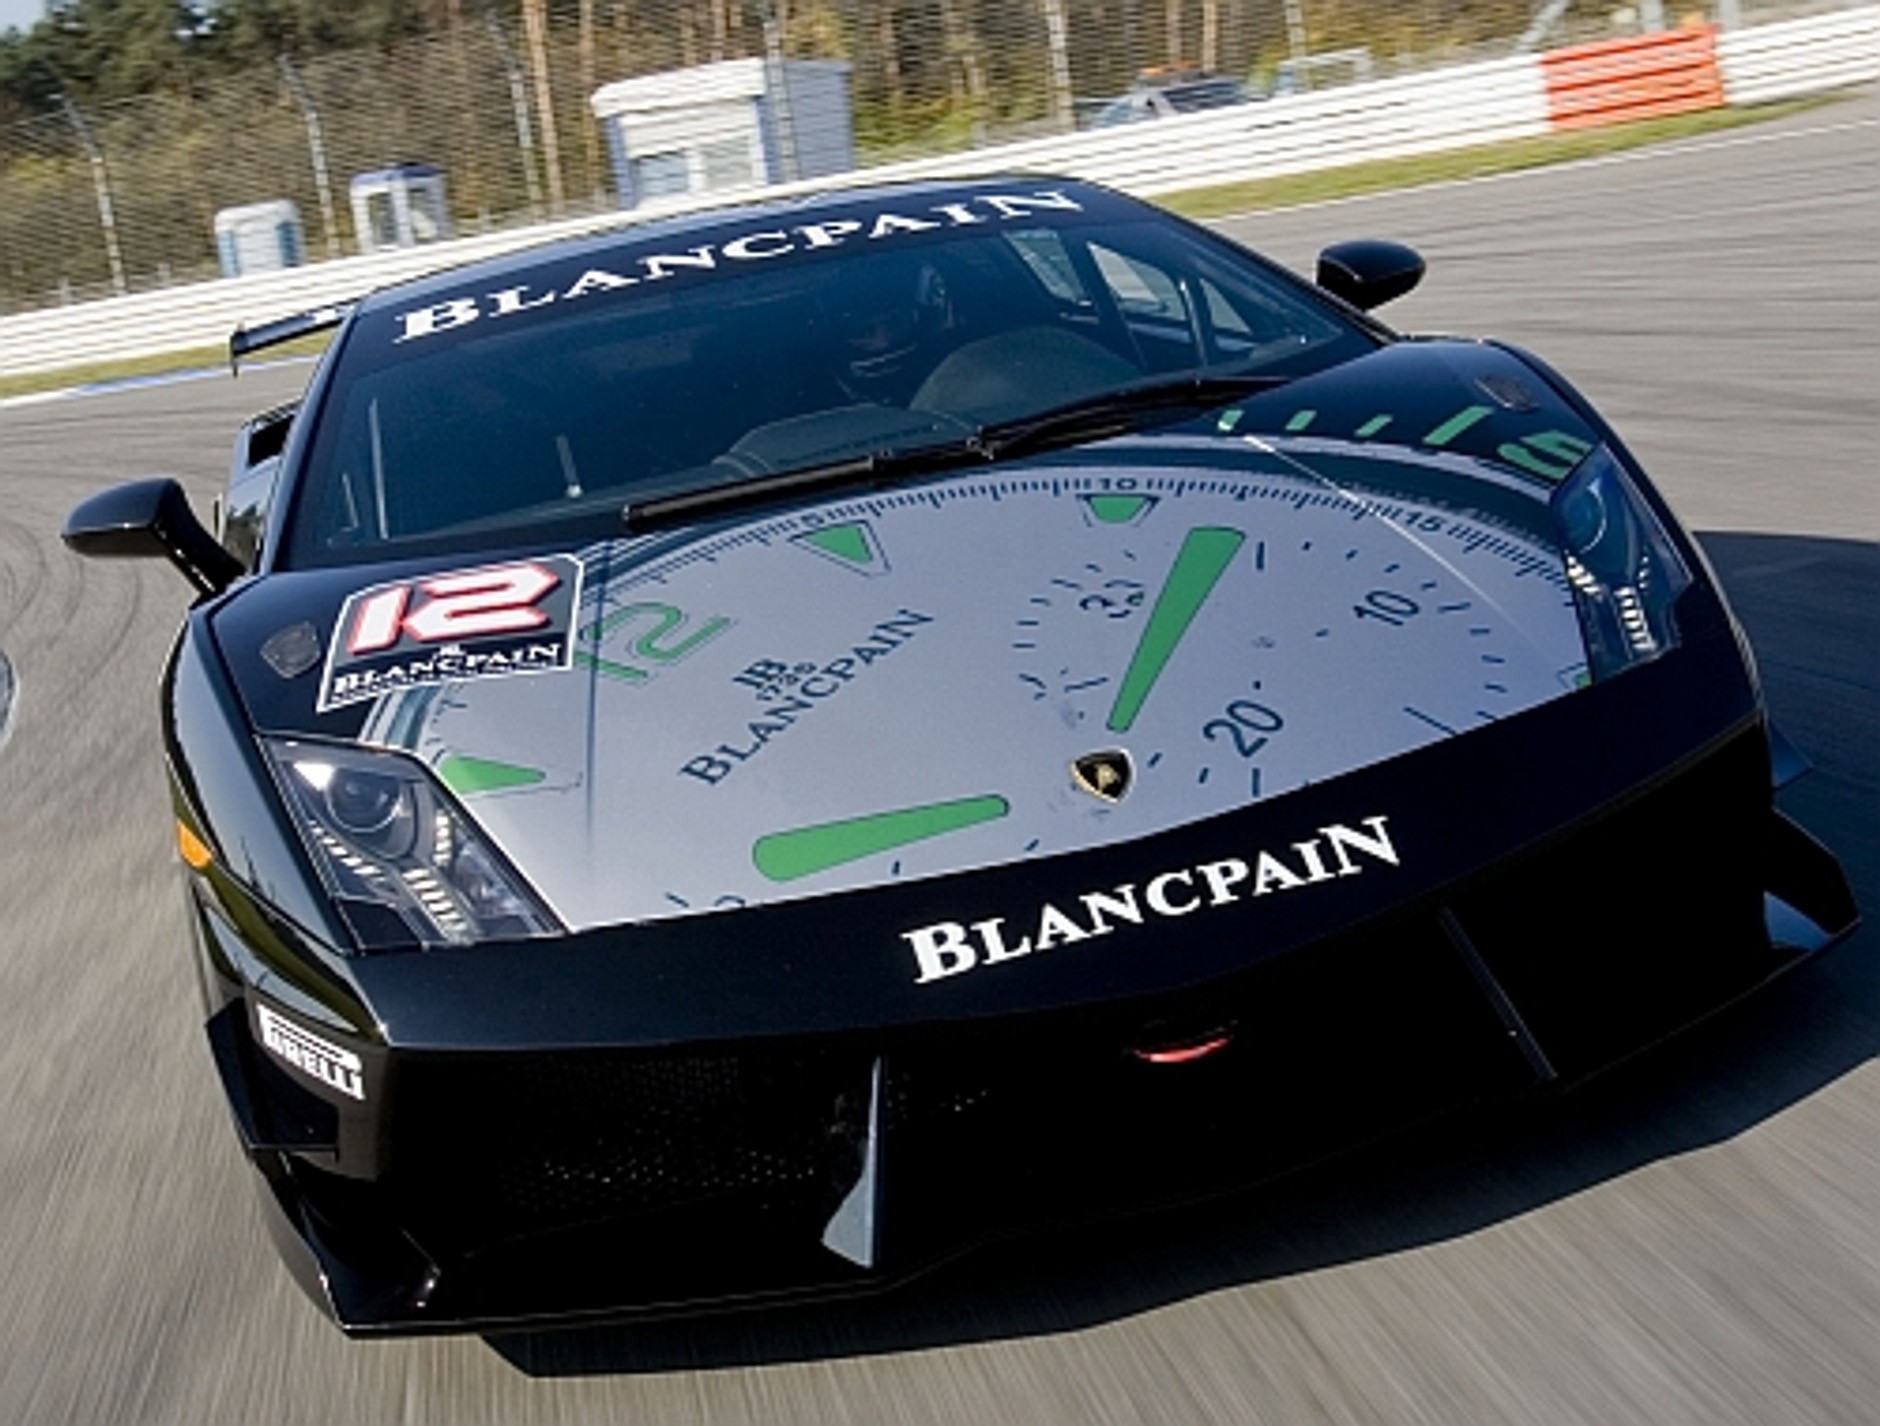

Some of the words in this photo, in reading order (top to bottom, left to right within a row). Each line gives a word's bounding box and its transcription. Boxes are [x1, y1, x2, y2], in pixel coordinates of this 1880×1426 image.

[394, 190, 1084, 343] BLANCPAIN
[1098, 478, 1137, 490] 10
[347, 564, 558, 654] 12
[1352, 590, 1420, 626] 10
[333, 644, 561, 694] BLANCPAIN
[679, 609, 933, 785] BLANCPAIN
[1203, 700, 1284, 757] 20
[901, 815, 1401, 985] BLANCPAIN
